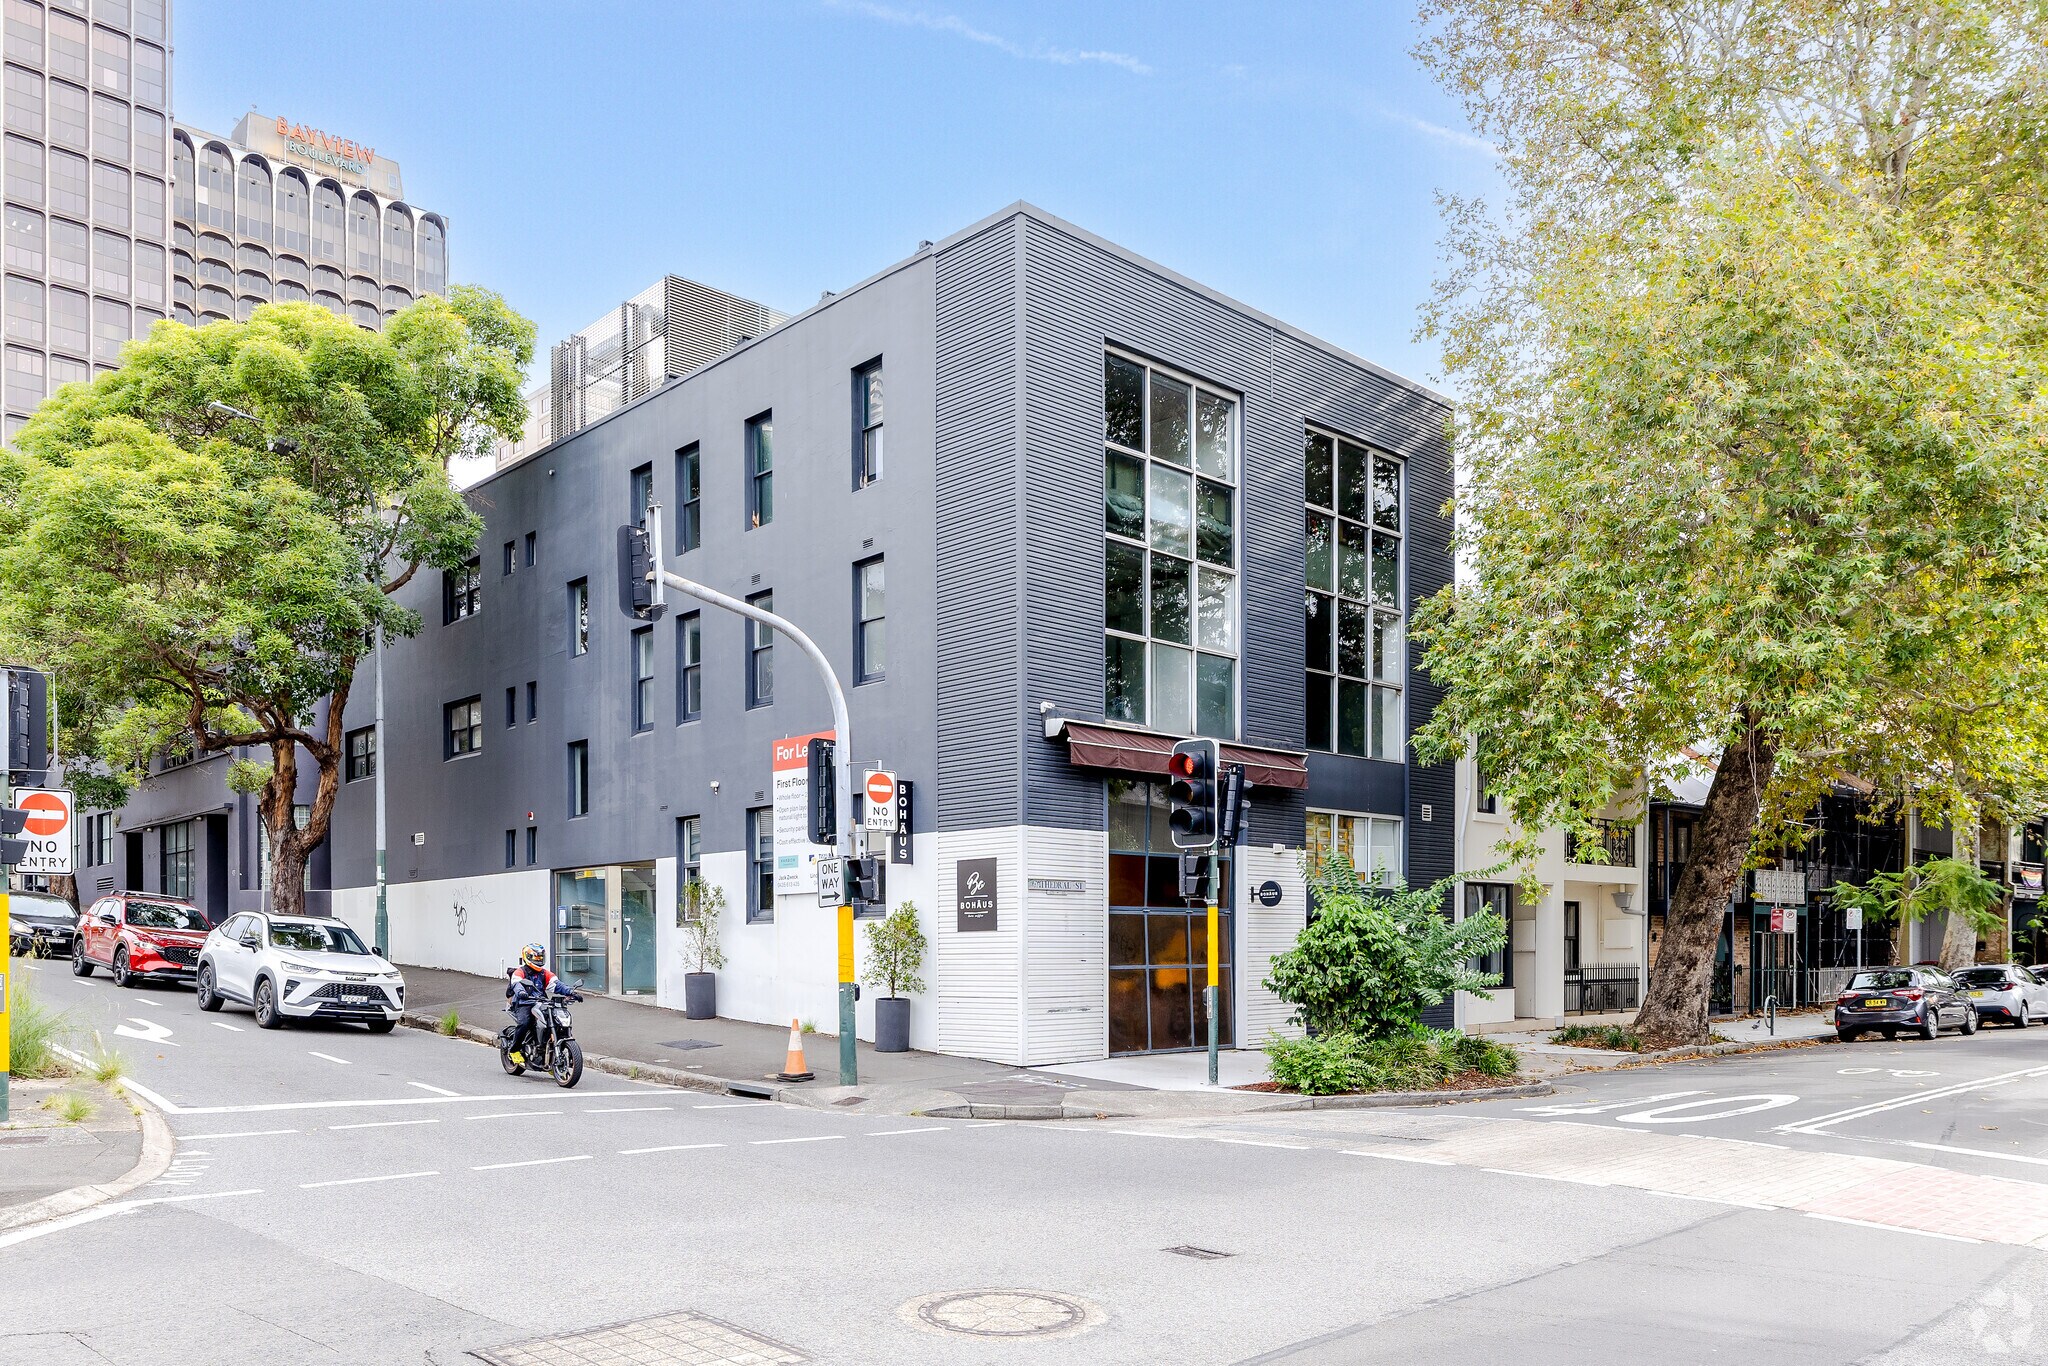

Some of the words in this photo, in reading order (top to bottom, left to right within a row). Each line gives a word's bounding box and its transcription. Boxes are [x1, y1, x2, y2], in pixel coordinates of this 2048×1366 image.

[276, 115, 376, 164] BAYVIEW
[288, 140, 366, 175] BOULEVARD
[776, 745, 795, 761] For
[776, 779, 791, 789] First
[872, 806, 888, 817] NO
[867, 818, 894, 827] ENTRY
[30, 840, 57, 853] NO
[20, 857, 68, 868] ENTRY
[821, 862, 839, 875] ONE
[821, 877, 840, 889] WAY
